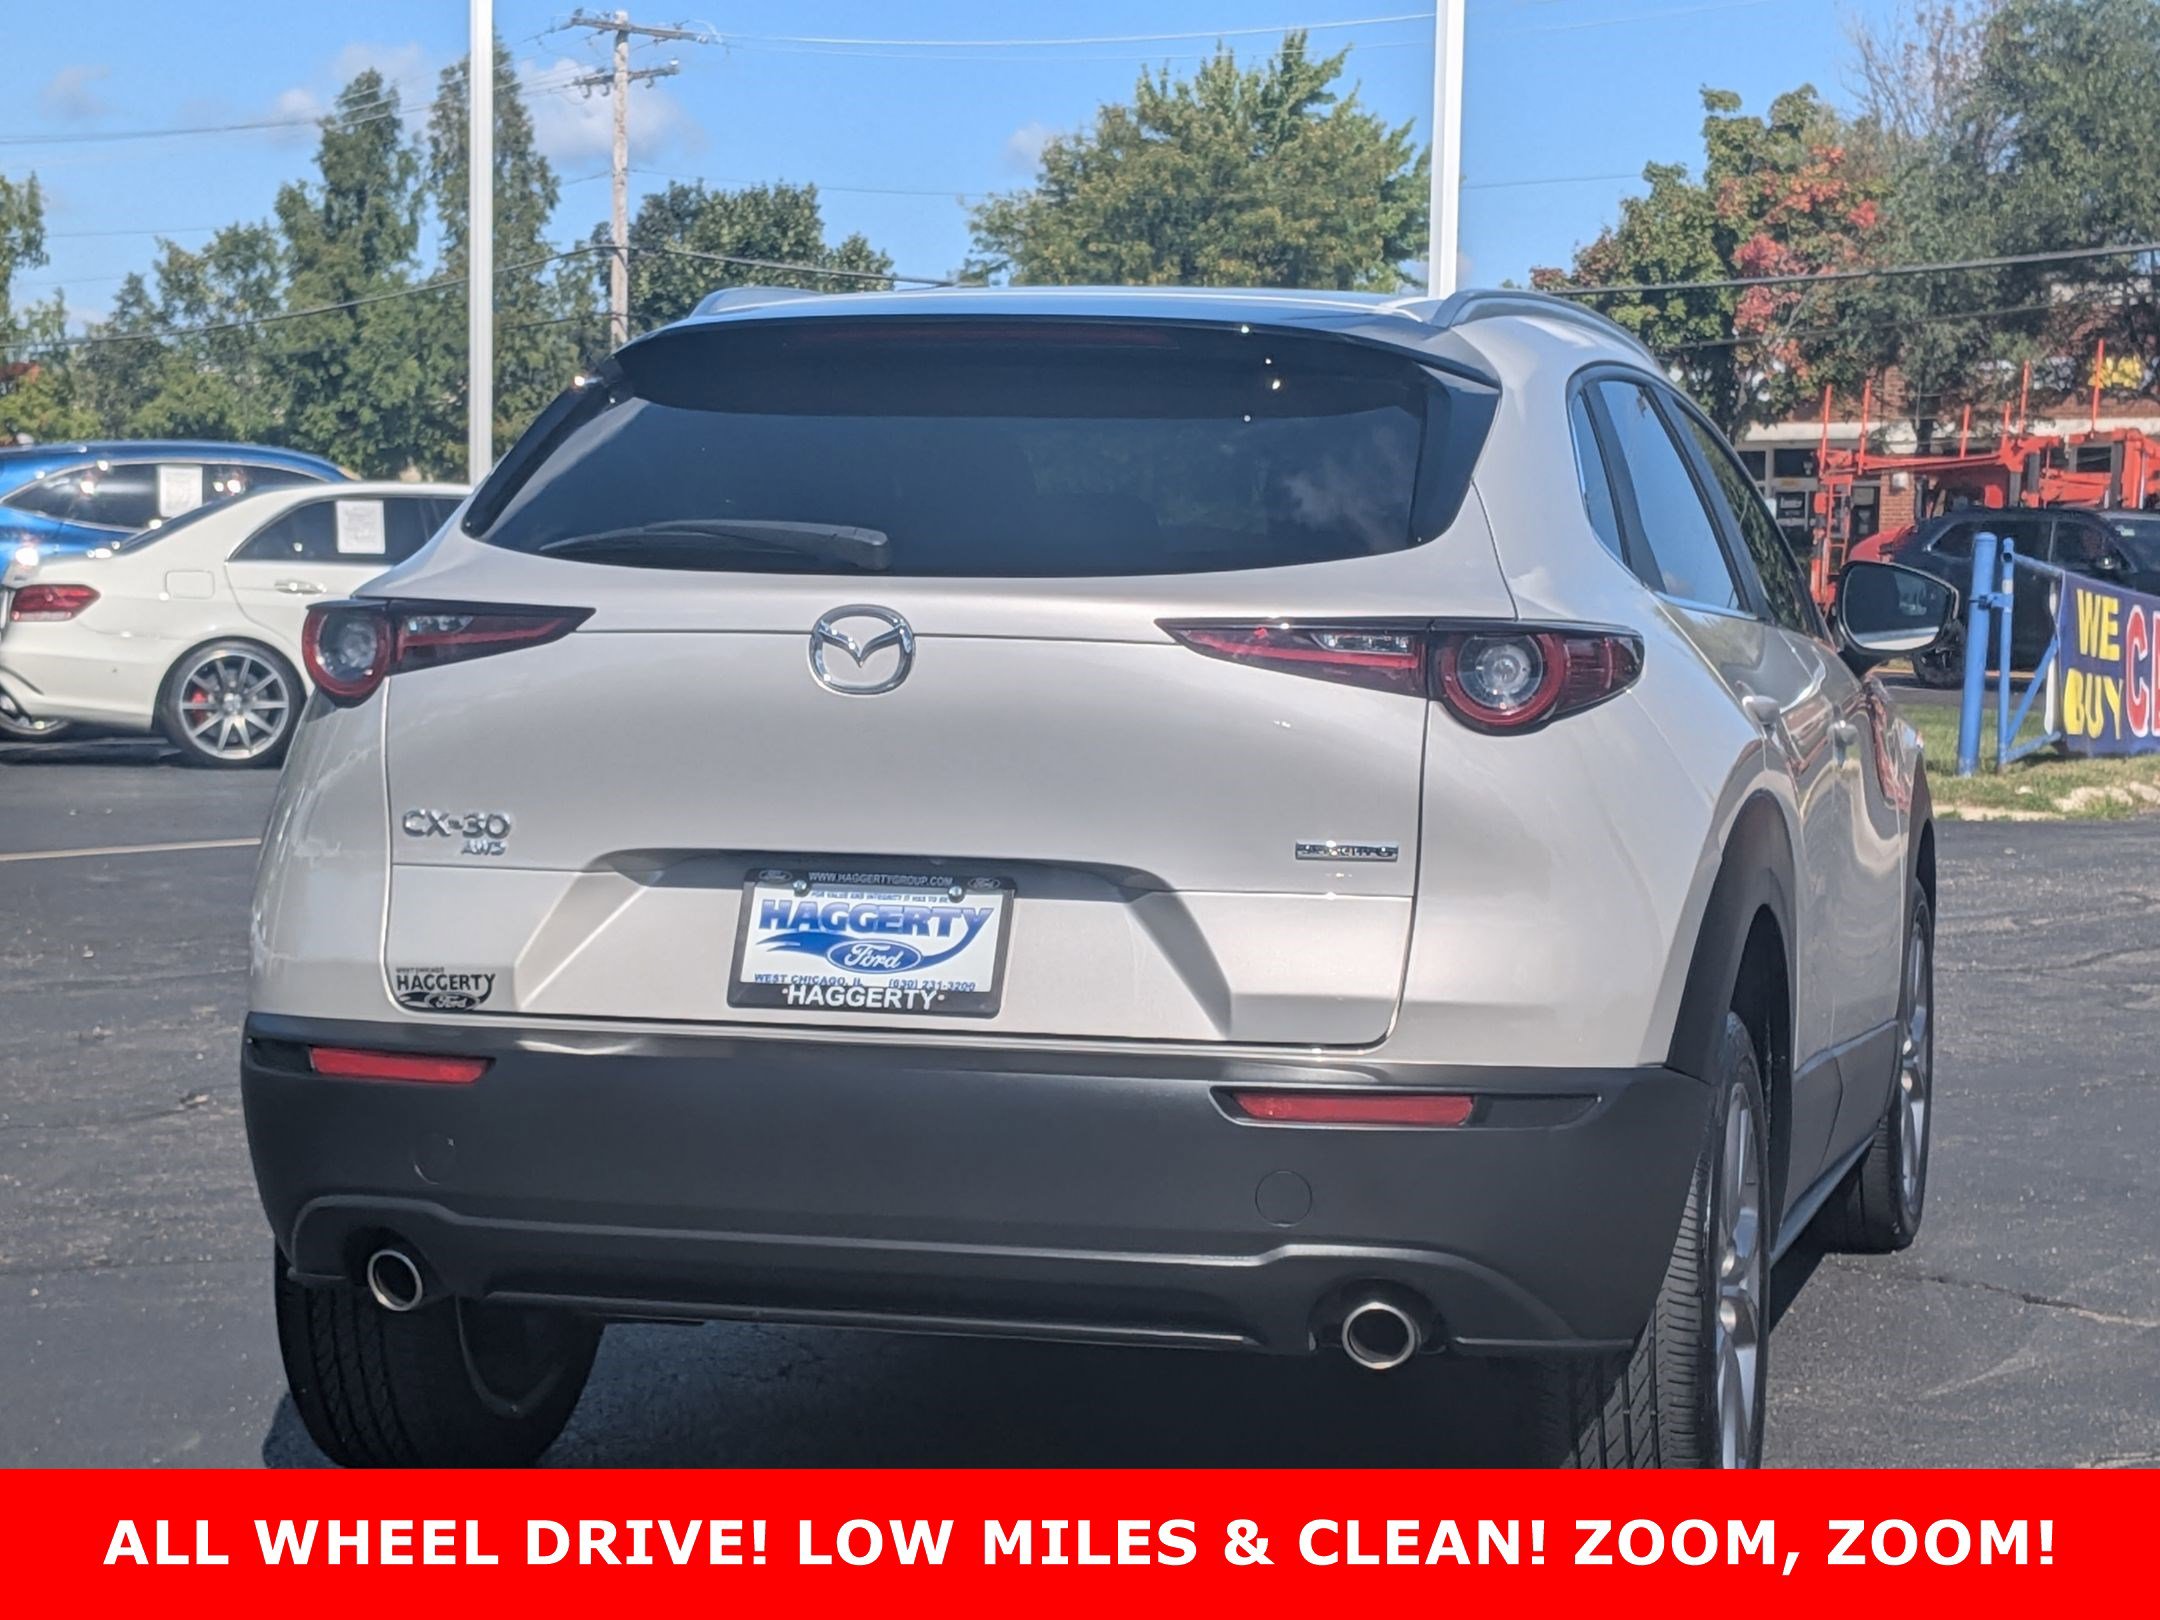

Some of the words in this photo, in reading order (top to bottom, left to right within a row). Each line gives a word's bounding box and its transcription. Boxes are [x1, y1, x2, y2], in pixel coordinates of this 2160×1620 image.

[2076, 588, 2120, 661] WE
[2063, 668, 2123, 740] BUY
[402, 809, 511, 839] CX-30
[808, 872, 953, 887] WWW.HAGGERTYGROUP.COM
[758, 899, 995, 938] HAGGERTY
[844, 943, 902, 969] Ford
[396, 973, 496, 991] HAGGERTY
[754, 974, 787, 983] WEST
[786, 986, 937, 1010] HAGGERTY
